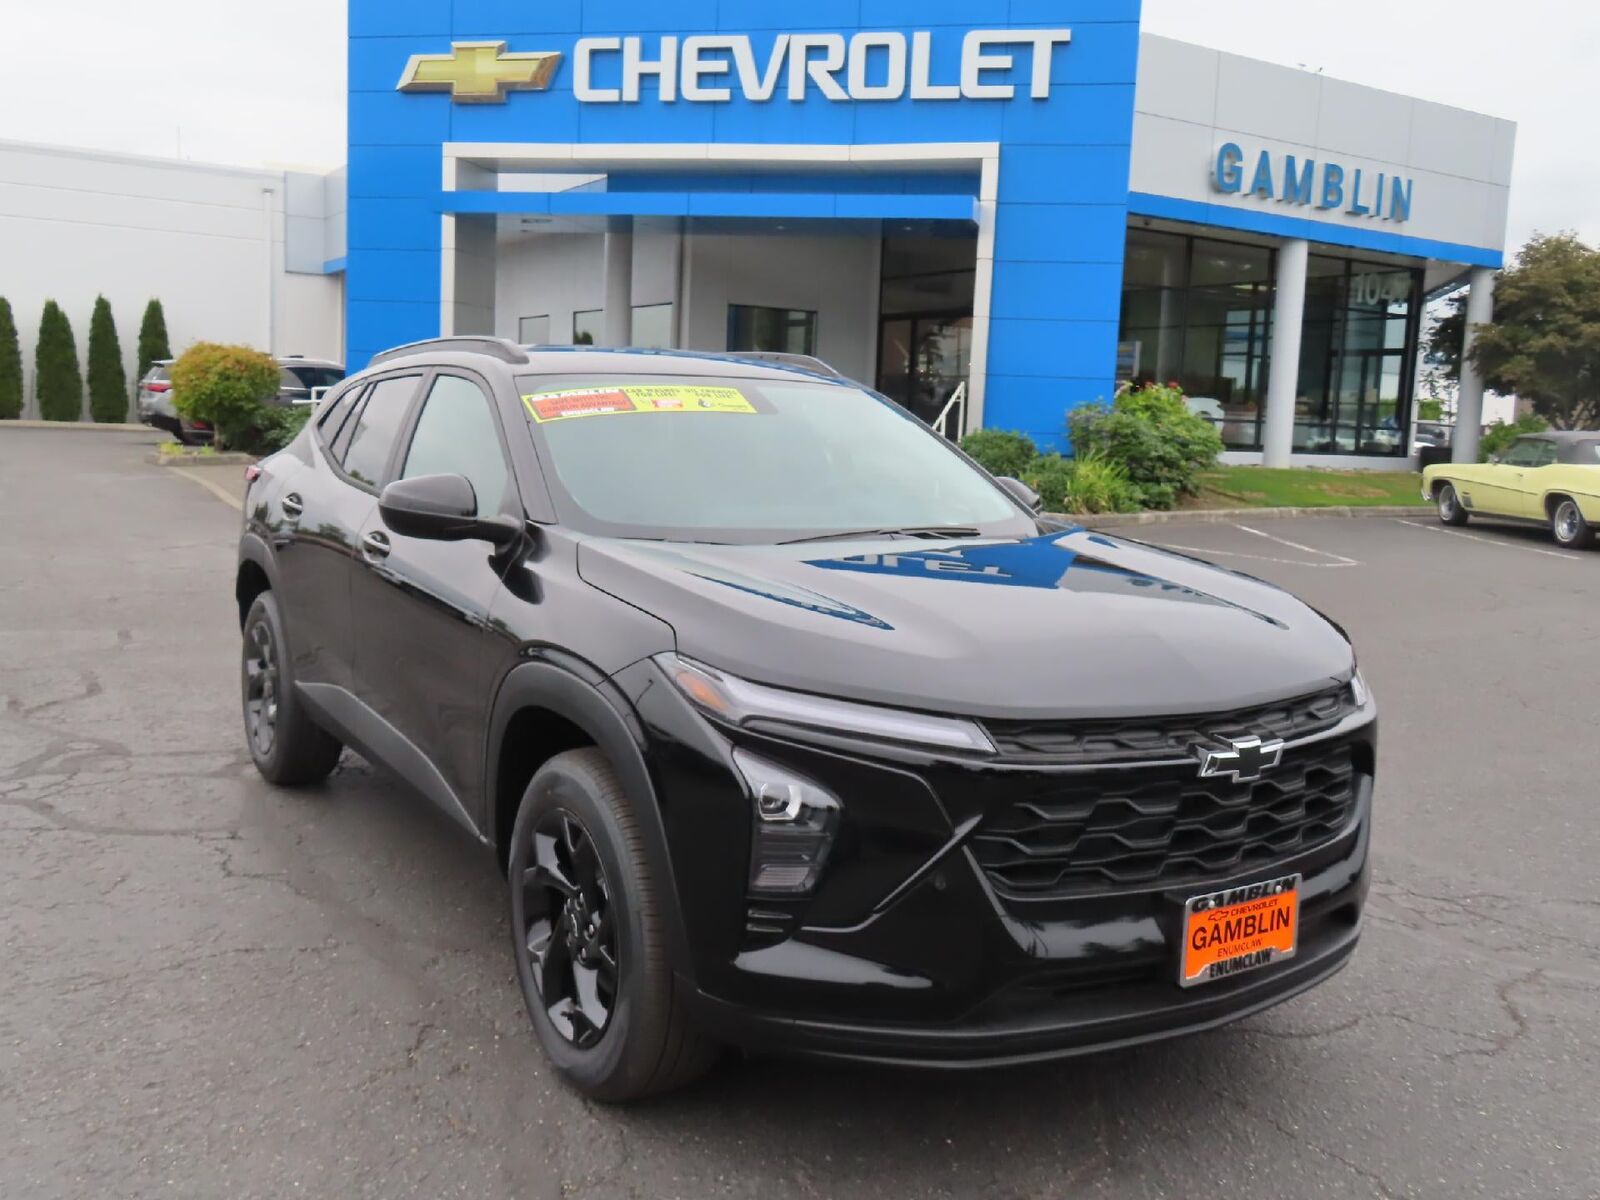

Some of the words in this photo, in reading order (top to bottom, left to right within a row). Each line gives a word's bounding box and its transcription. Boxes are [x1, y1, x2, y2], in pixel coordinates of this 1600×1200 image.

[573, 29, 1071, 102] CHEVROLET
[1216, 142, 1412, 221] GAMBLIN
[1192, 876, 1296, 912] GAMBLIN
[1231, 899, 1278, 916] CHEVROLET
[1192, 906, 1290, 950] GAMBLIN
[1209, 948, 1272, 977] ENUMCLAW
[1217, 939, 1262, 957] ENUMCLAW
